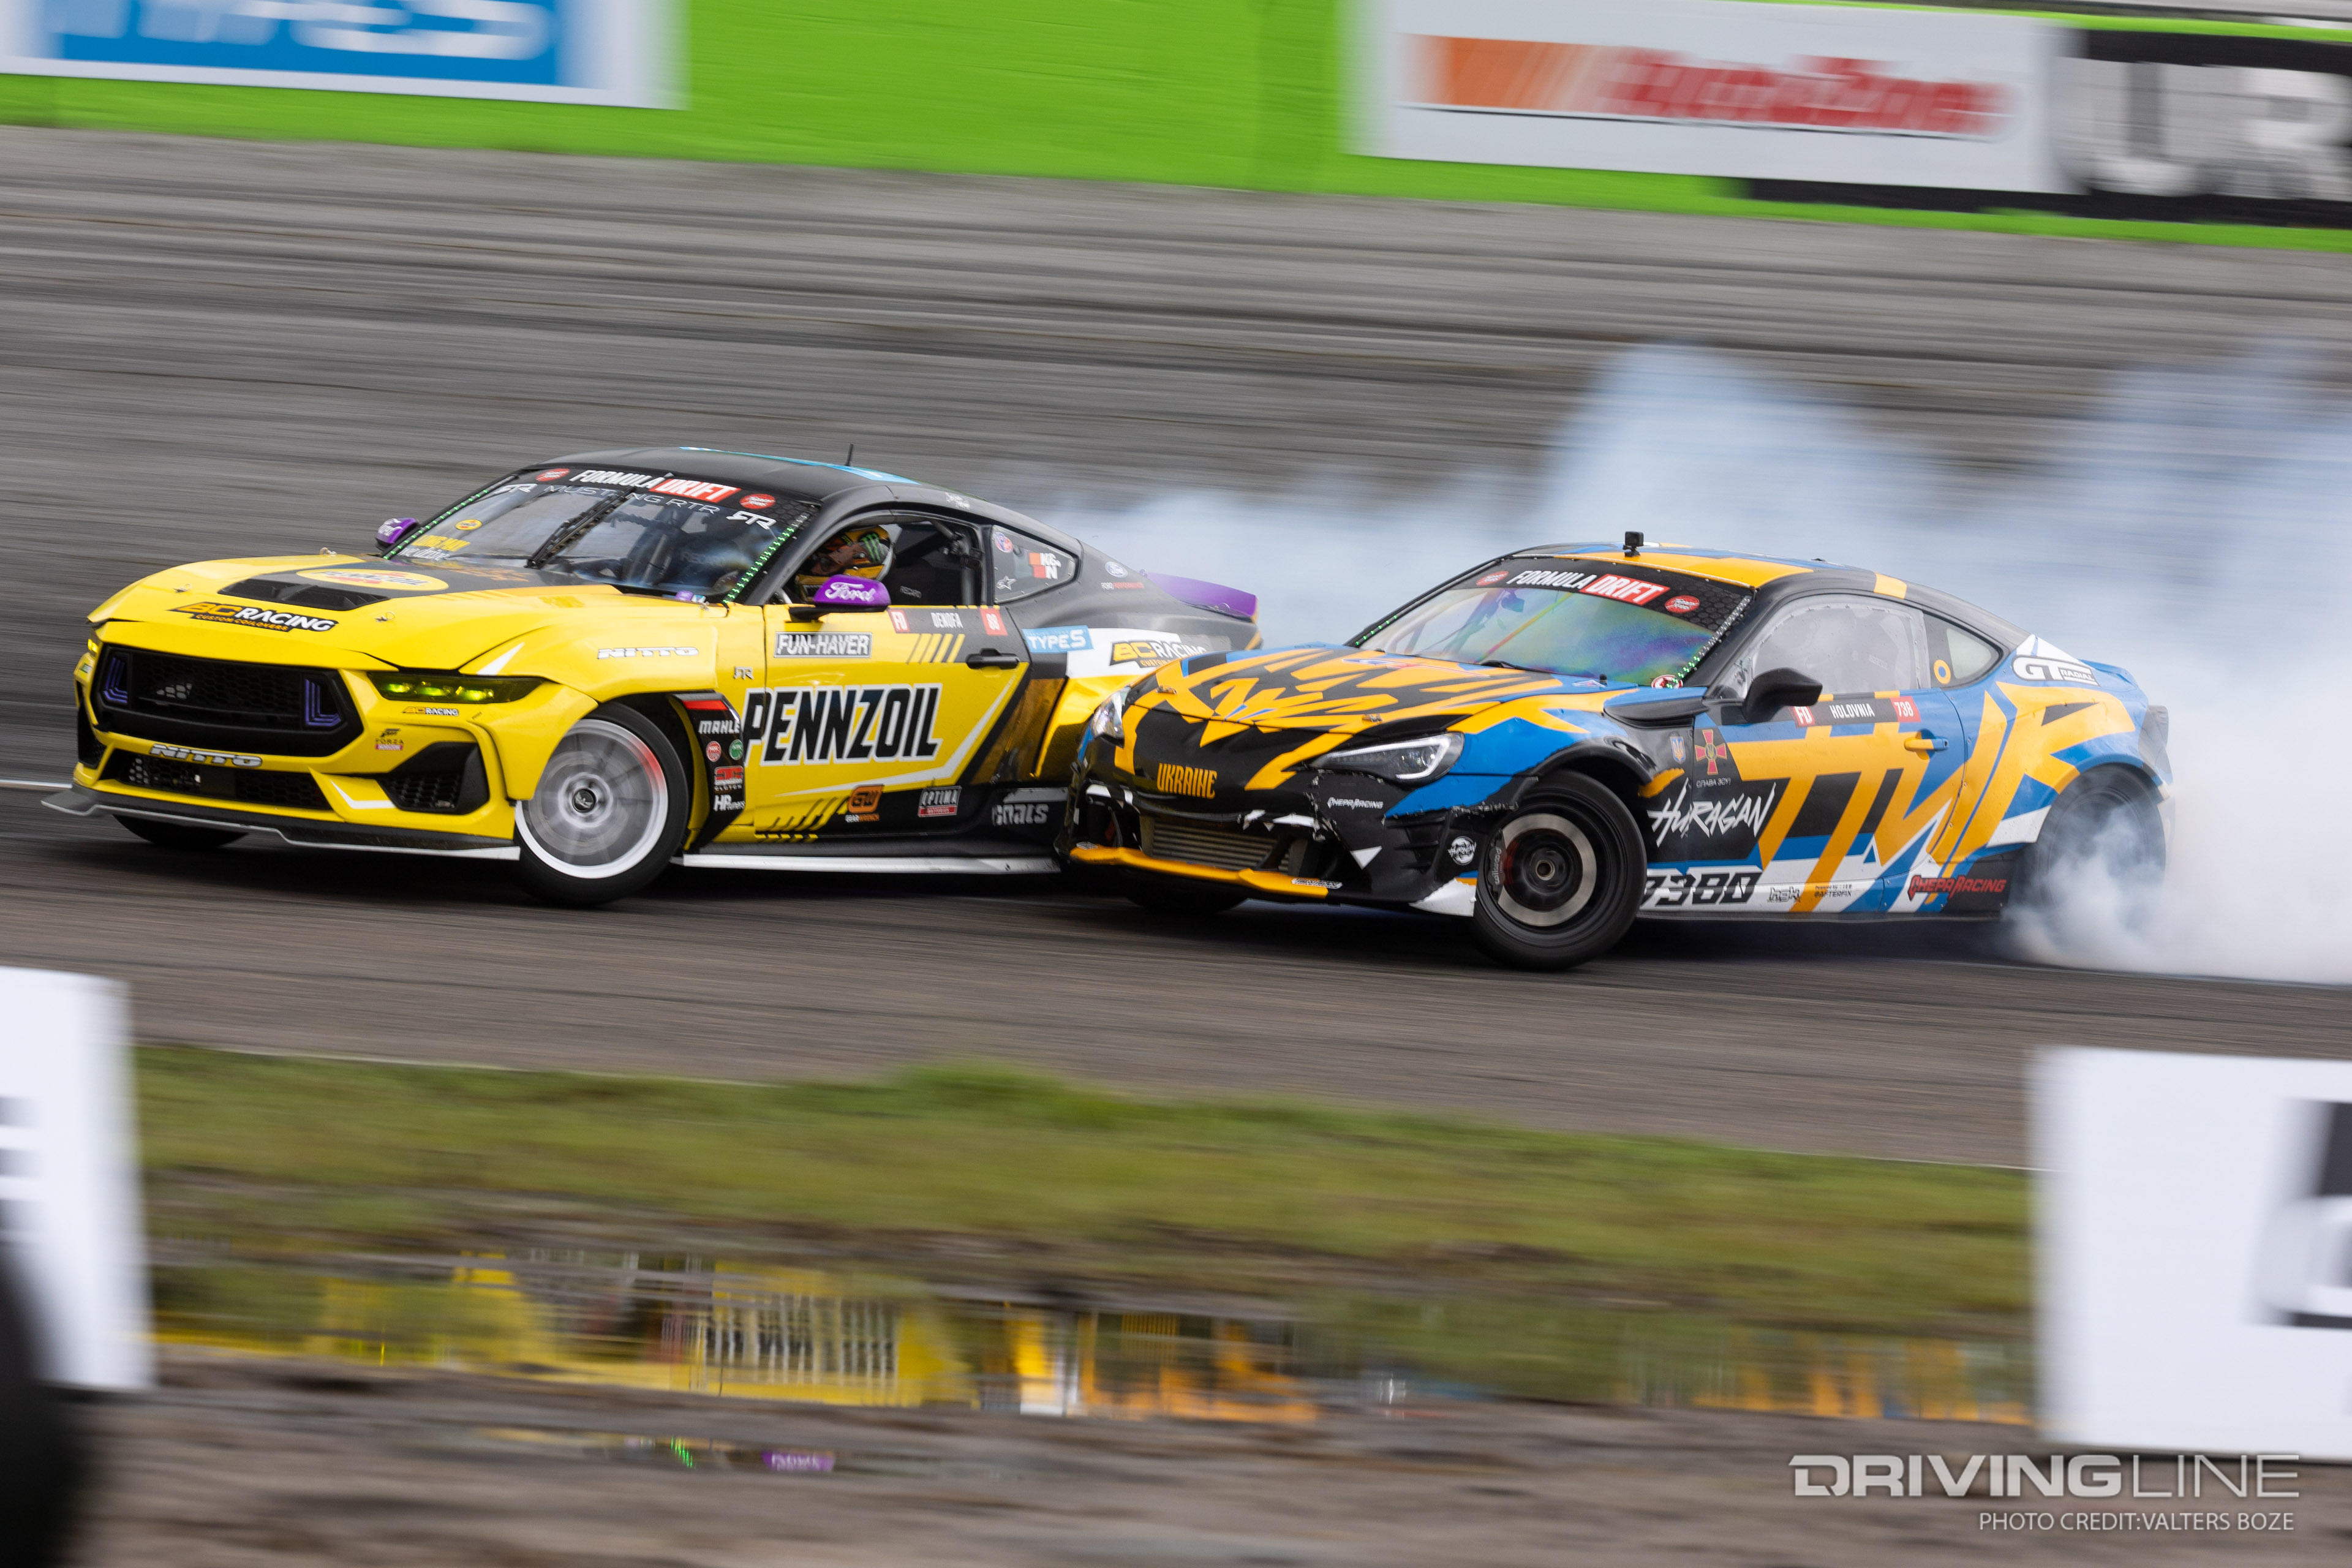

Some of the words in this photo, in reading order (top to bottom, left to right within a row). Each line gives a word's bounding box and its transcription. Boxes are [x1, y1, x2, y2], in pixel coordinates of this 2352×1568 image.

[569, 469, 665, 489] FORMULA
[654, 478, 737, 501] DRIFT
[545, 485, 663, 503] MUSTNG
[666, 498, 720, 514] RTR
[825, 582, 876, 601] Ford
[1506, 570, 1597, 589] FORMULA
[1585, 575, 1664, 603] DRIFT
[195, 614, 234, 623] CUSTOM
[235, 608, 336, 631] RACING
[891, 611, 908, 631] FD
[597, 646, 699, 660] NITTO
[776, 634, 870, 655] FUN-HAVER
[1113, 642, 1158, 662] BC
[2013, 656, 2087, 680] GT
[2059, 668, 2095, 682] RADIAL
[425, 707, 459, 717] RACING
[1794, 706, 1813, 725] FD
[1829, 703, 1875, 719] HOLOVNIA
[1893, 701, 1914, 718] 738
[698, 720, 741, 734] MAHLE
[742, 684, 943, 766] PENNZOIL
[149, 743, 263, 767] NITTO
[1156, 763, 1218, 799] UKRAINE
